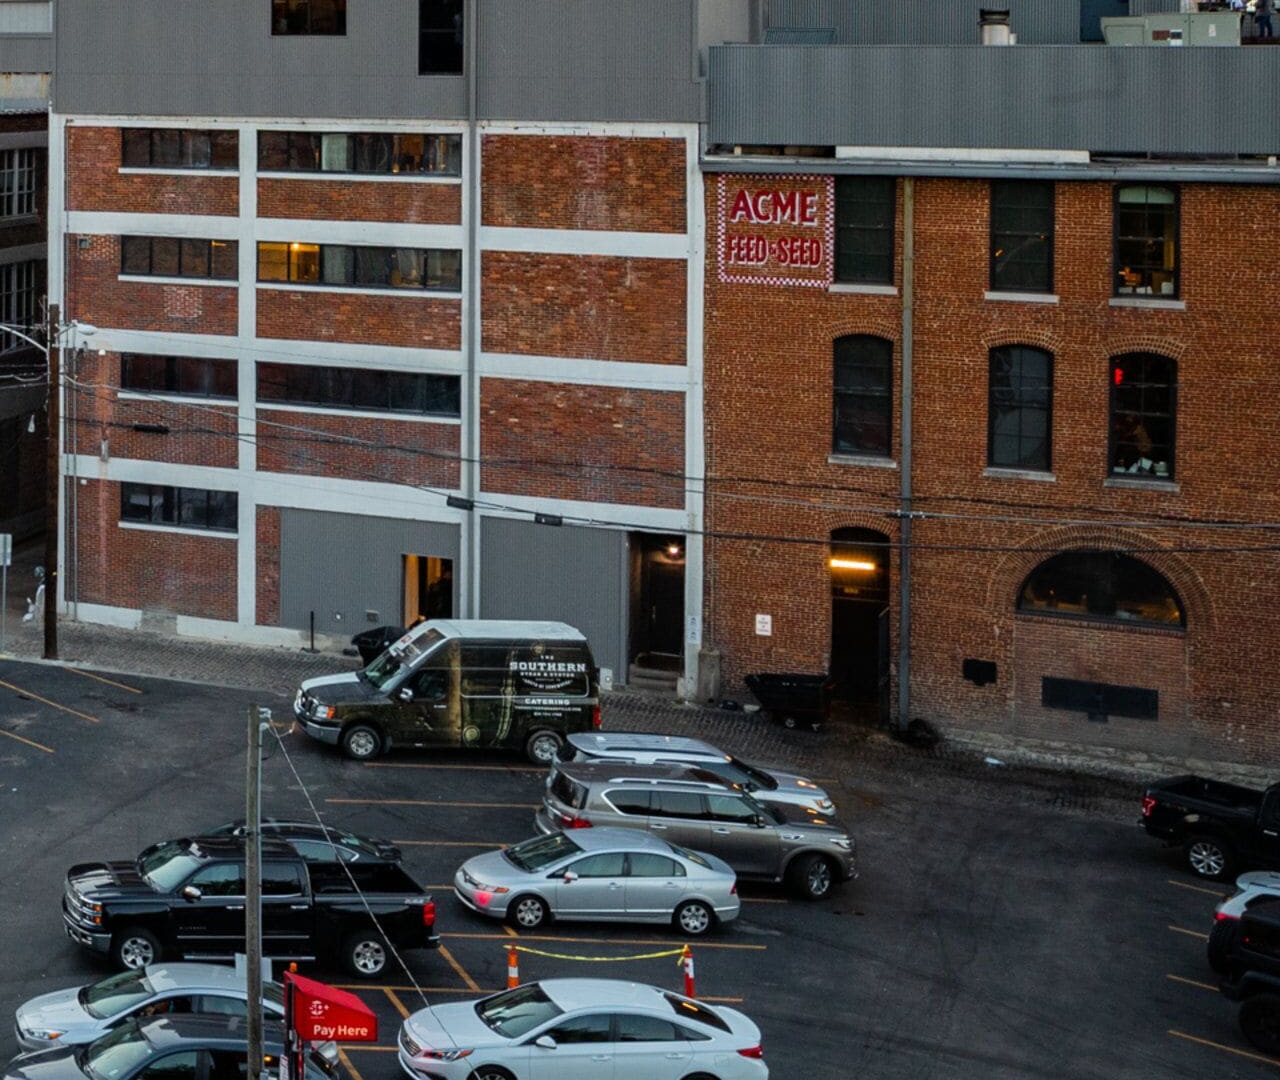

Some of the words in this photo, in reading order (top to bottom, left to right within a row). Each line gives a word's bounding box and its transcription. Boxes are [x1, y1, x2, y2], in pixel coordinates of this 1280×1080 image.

[730, 189, 819, 226] ACME
[727, 234, 769, 266] FEED
[777, 236, 823, 268] SEED
[510, 661, 587, 672] SOUTHERN
[524, 698, 570, 706] CATERING
[313, 1024, 336, 1038] Pay
[337, 1024, 369, 1036] Here
